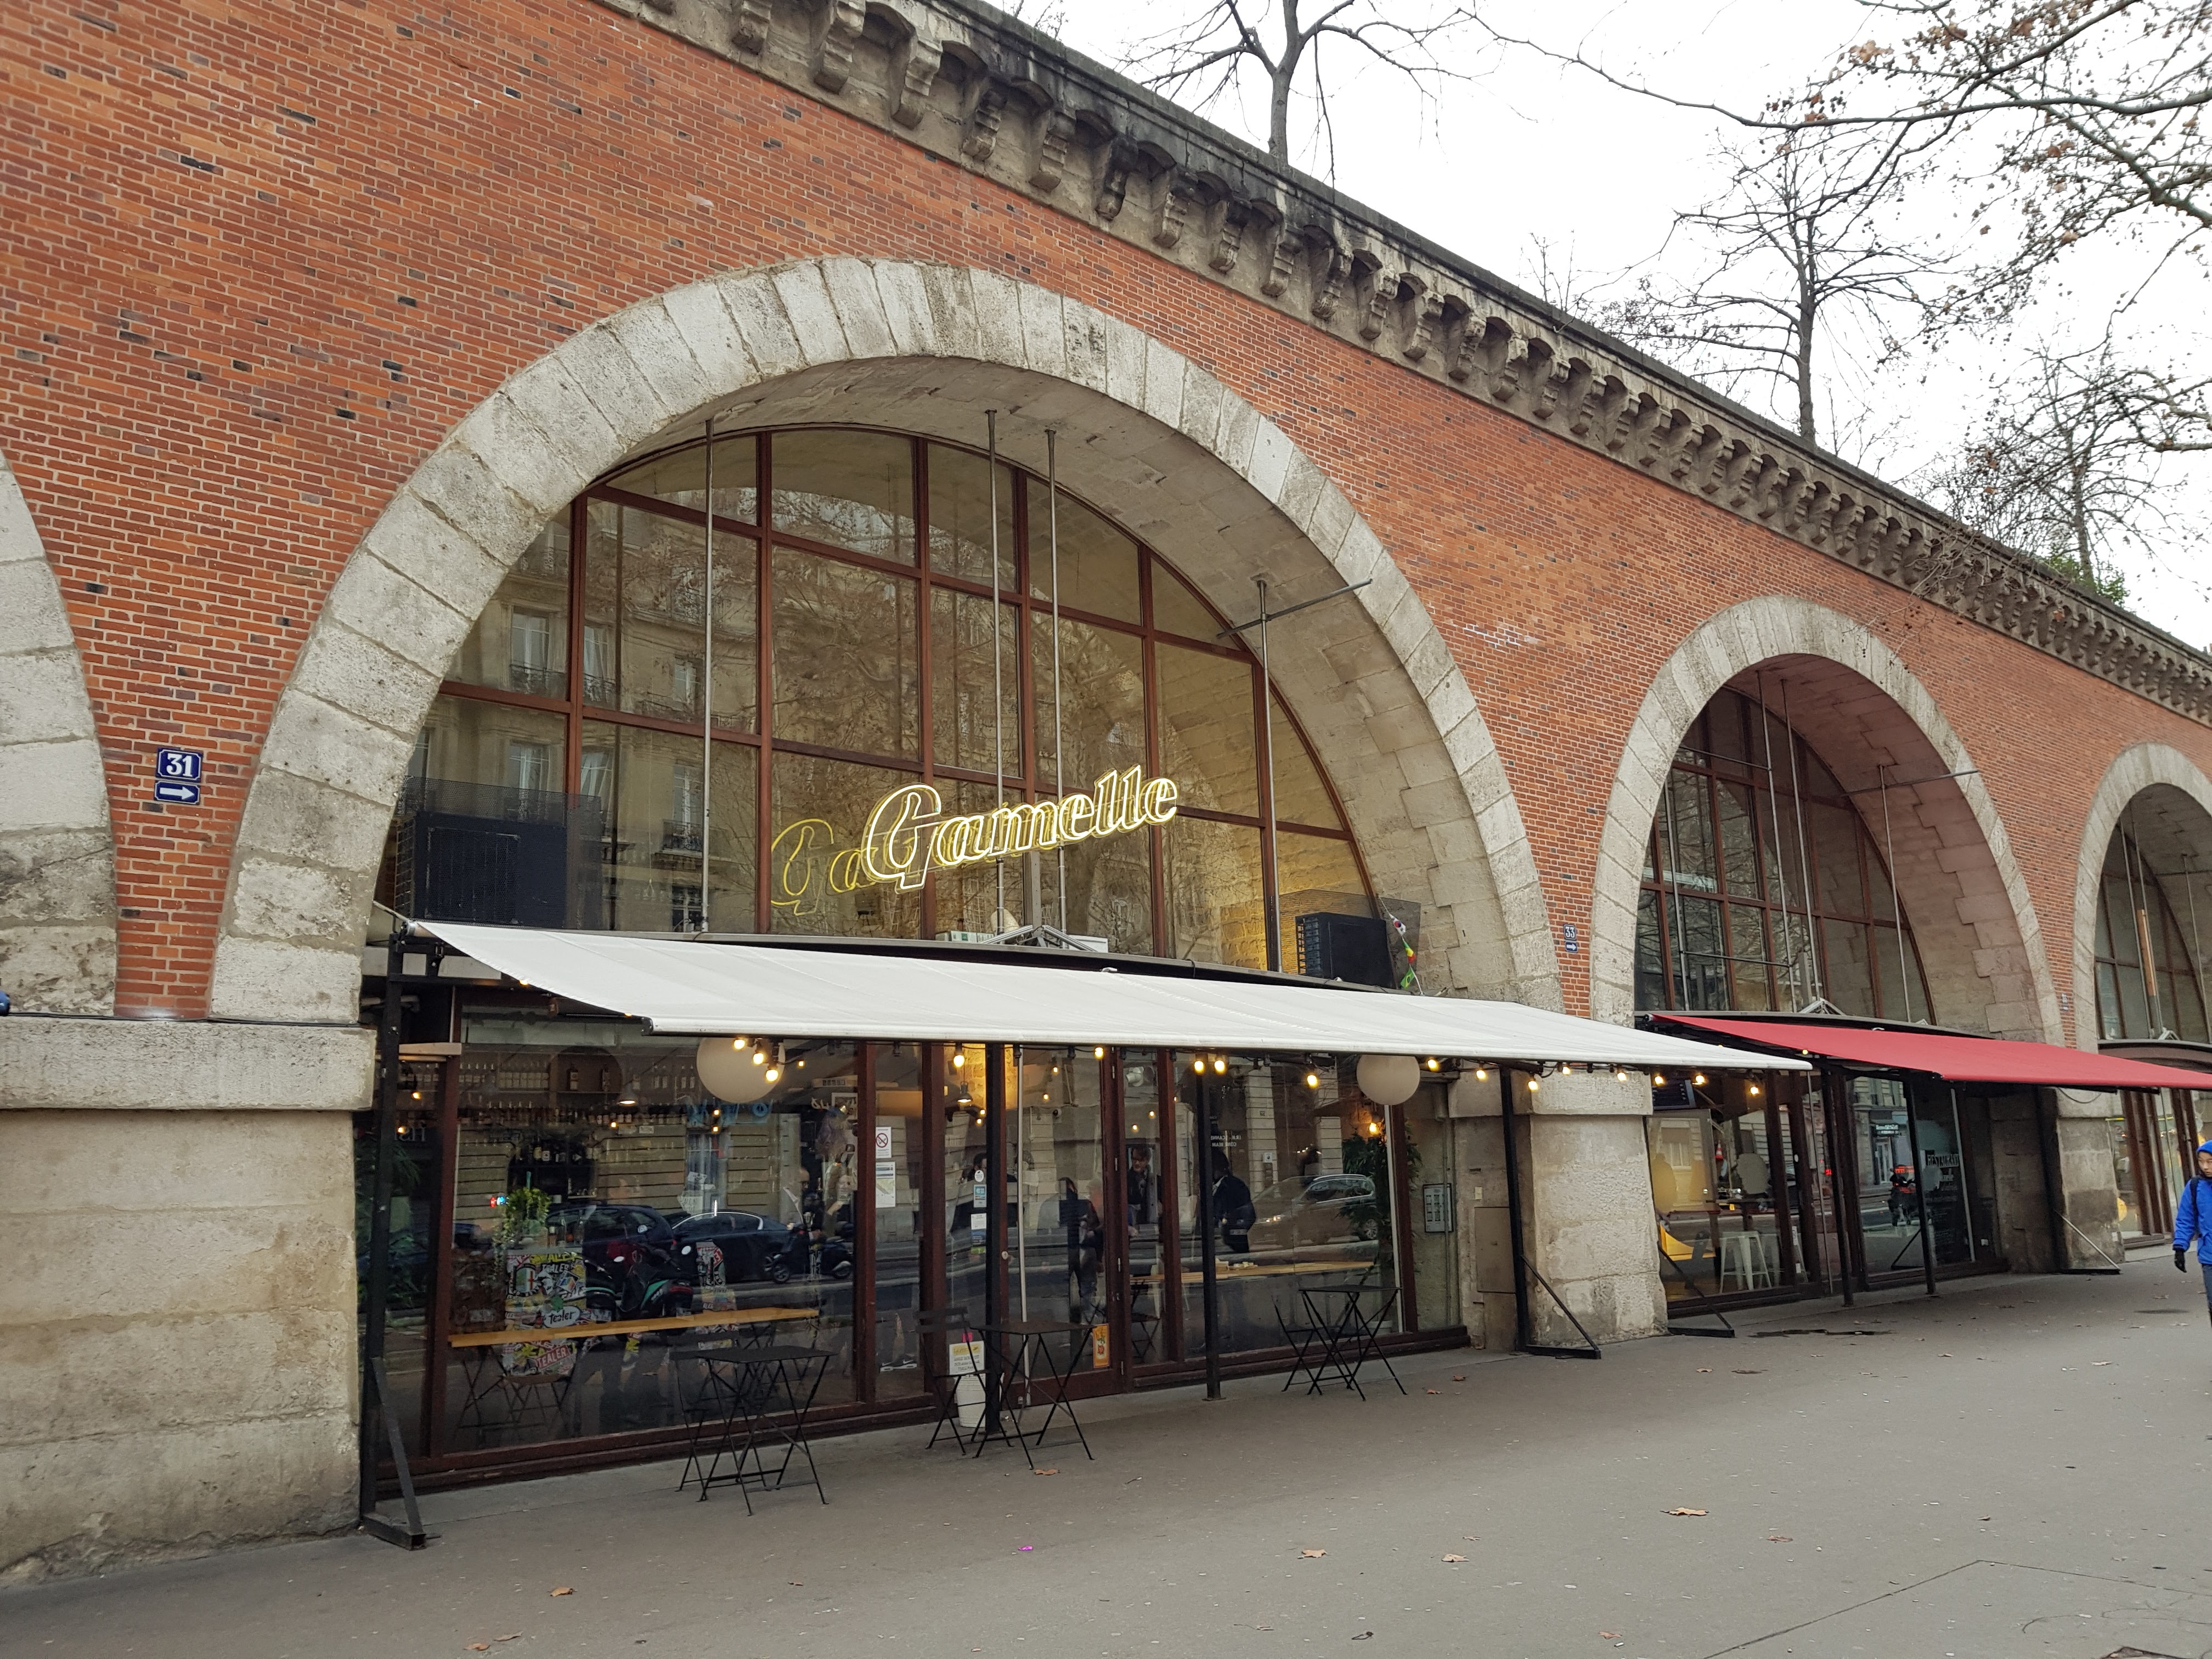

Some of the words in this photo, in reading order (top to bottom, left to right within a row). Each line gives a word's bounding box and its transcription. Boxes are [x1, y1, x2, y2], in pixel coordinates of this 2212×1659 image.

[166, 753, 193, 777] 31
[864, 764, 1178, 893] Gamelle
[1565, 926, 1575, 938] 33
[537, 1347, 567, 1369] TEALER
